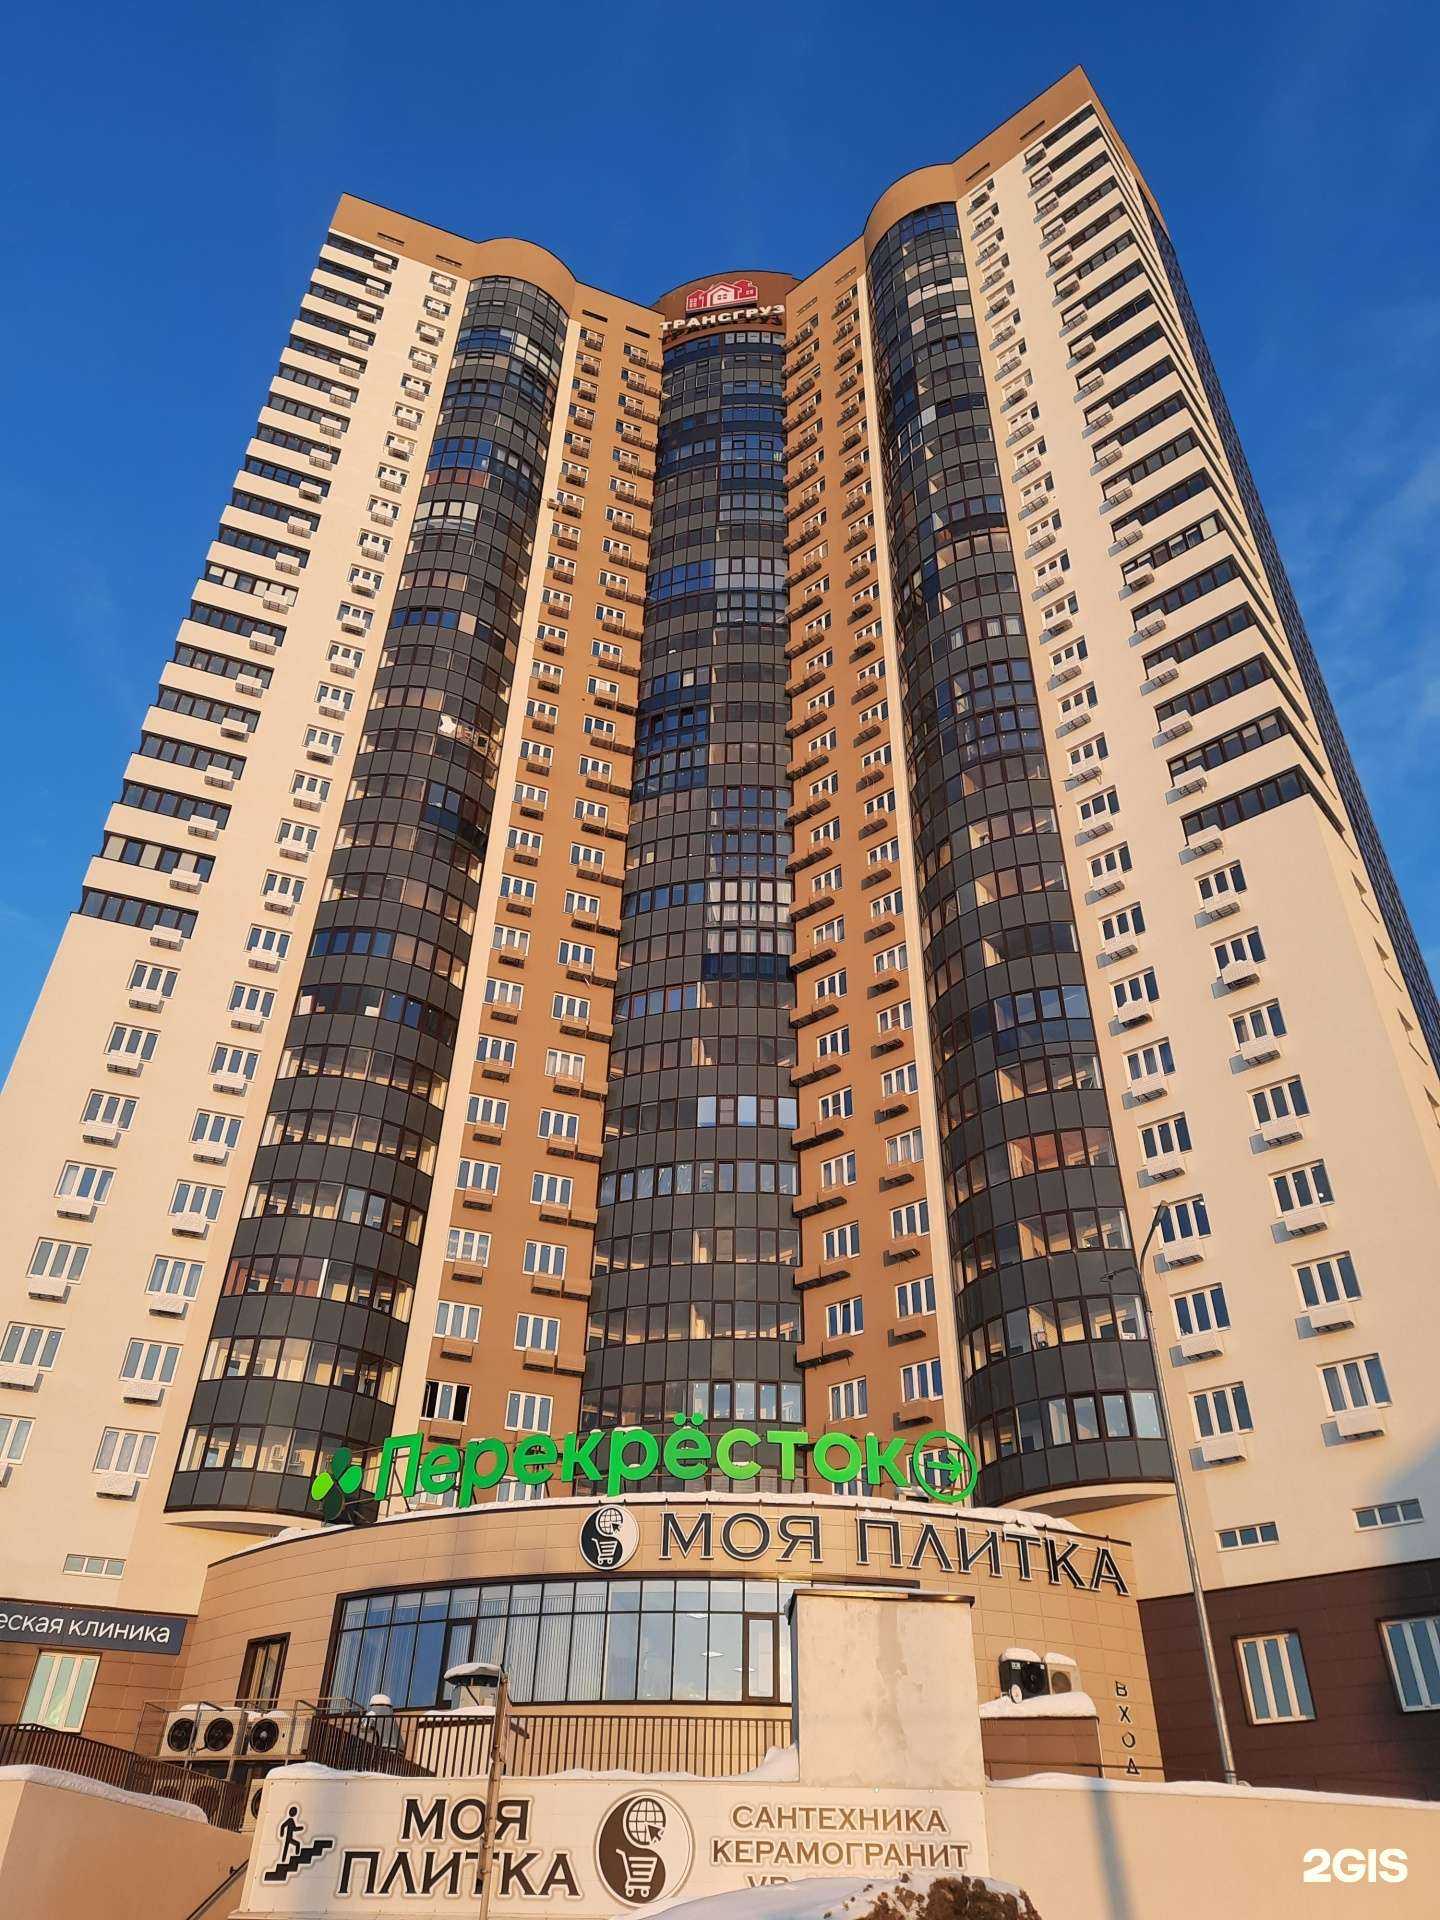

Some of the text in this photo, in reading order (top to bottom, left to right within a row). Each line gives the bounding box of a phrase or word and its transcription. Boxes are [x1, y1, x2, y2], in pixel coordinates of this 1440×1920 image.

[660, 304, 785, 330] ТРАНСГРУЗ
[374, 1412, 908, 1508] Перекрёсток
[659, 1511, 1131, 1597] МОЯ ПЛИТКА
[69, 1619, 171, 1643] клиника
[400, 1798, 530, 1841] МОЯ
[732, 1805, 948, 1833] САНТЕХНИКА
[712, 1839, 969, 1868] КЕРАМОГРАНИТ
